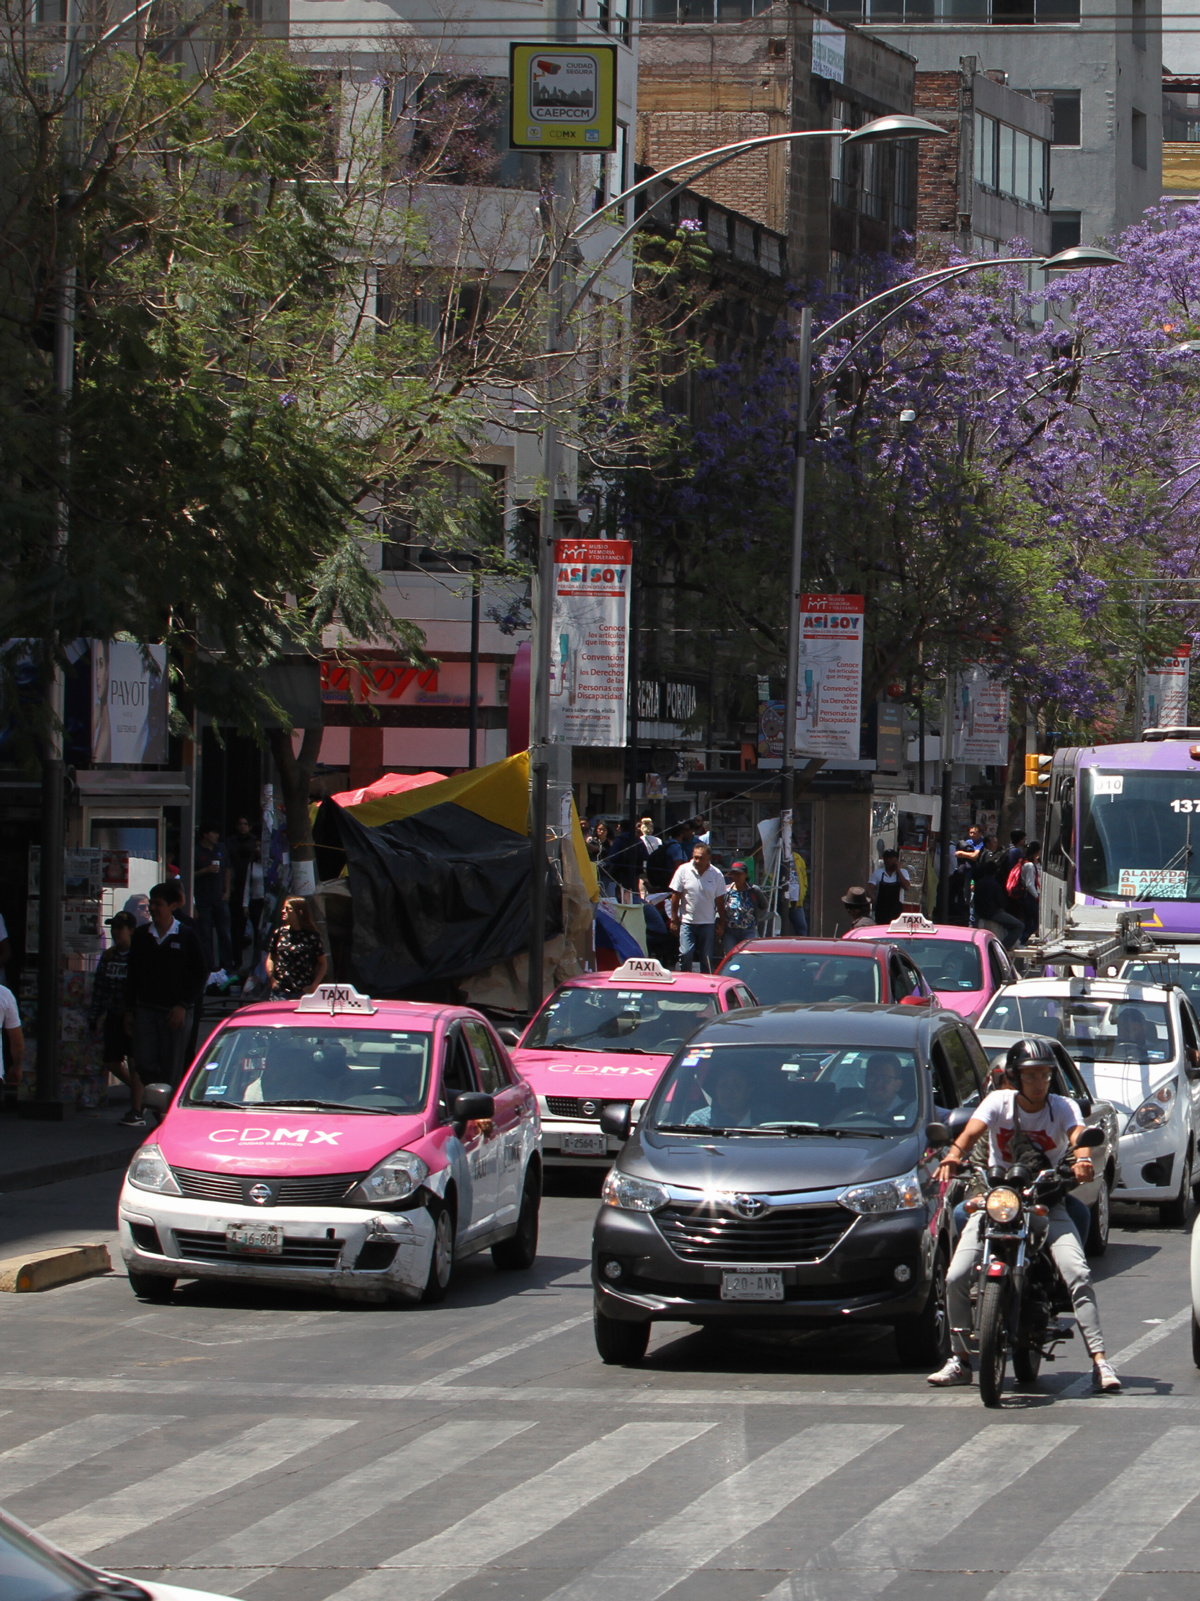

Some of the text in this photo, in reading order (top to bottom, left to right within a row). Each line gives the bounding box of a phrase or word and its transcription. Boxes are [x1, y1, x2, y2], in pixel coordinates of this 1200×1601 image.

[536, 108, 590, 118] CAEPCCM
[549, 130, 576, 138] CDMX
[590, 568, 626, 583] SOY
[830, 616, 860, 629] SOY
[599, 624, 625, 632] Conoce
[581, 653, 625, 661] Convención
[578, 684, 612, 692] Personas
[111, 680, 147, 707] PAYOT
[902, 916, 922, 924] TAXI
[629, 961, 655, 971] TAXI
[320, 989, 349, 1001] TAXI
[548, 1064, 657, 1076] CDMX
[208, 1128, 344, 1146] CDMX
